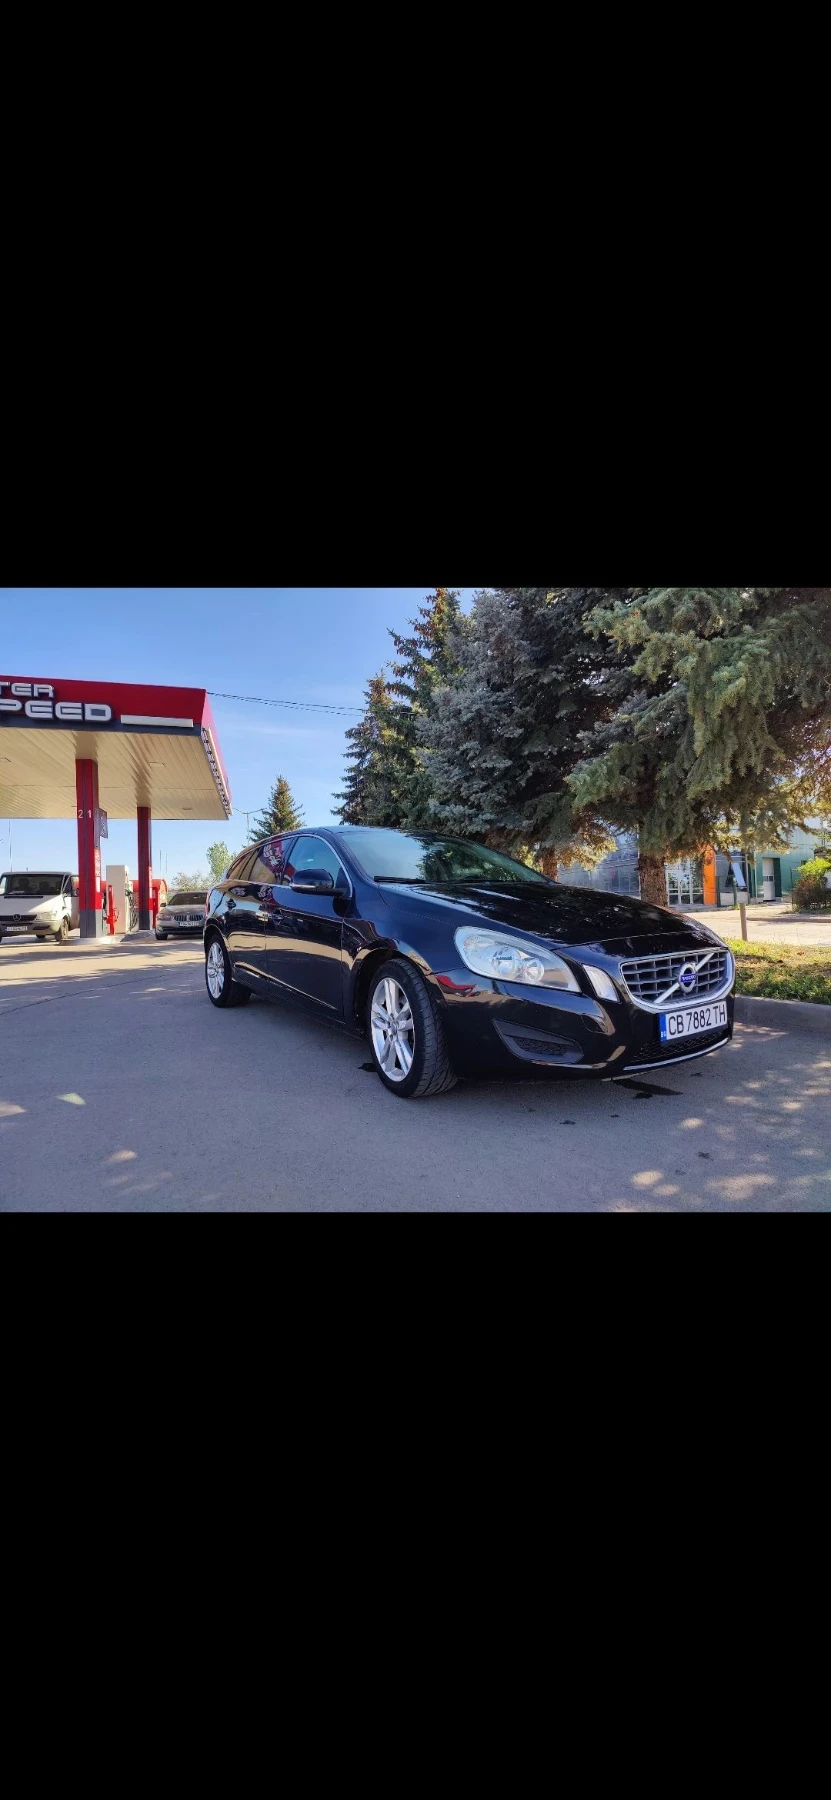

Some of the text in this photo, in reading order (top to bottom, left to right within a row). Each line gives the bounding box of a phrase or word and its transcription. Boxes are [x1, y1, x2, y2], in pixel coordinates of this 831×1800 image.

[0, 699, 111, 721] PEED
[78, 809, 92, 818] 2 1
[668, 1004, 726, 1035] CB 7882 TH
